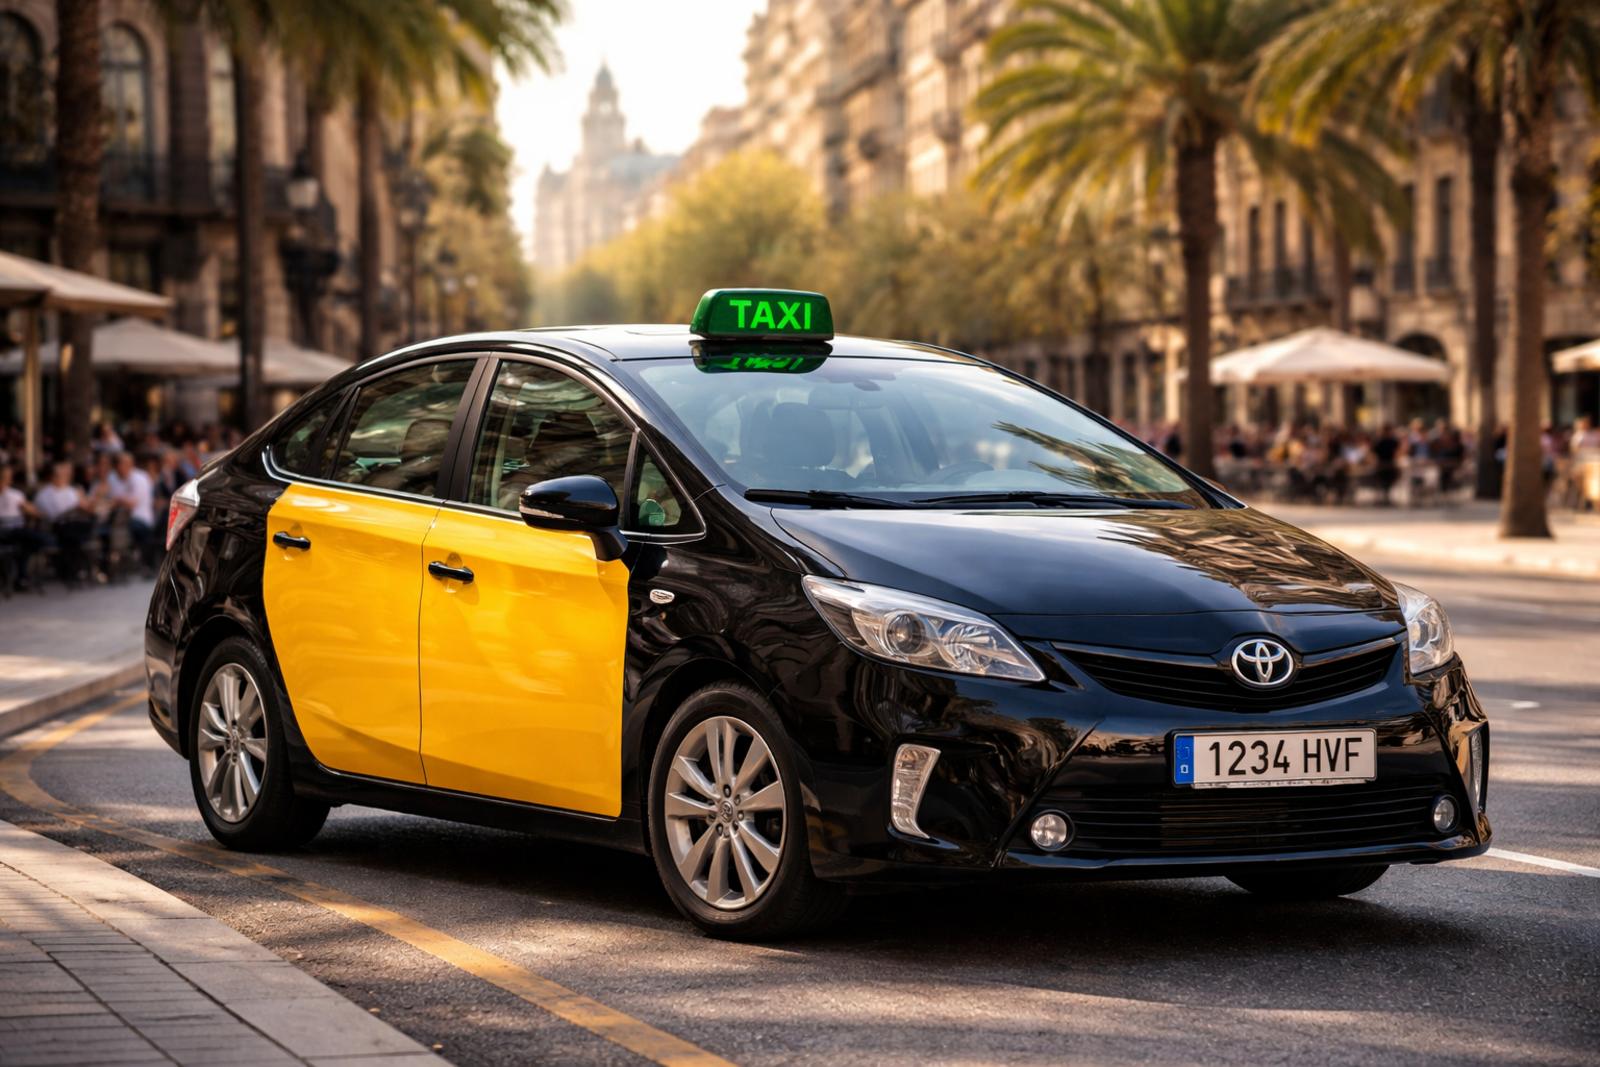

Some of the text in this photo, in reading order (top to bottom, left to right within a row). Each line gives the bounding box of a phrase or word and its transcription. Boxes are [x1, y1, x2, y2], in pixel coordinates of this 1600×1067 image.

[729, 299, 812, 330] TAXI
[1208, 737, 1363, 776] 1234 HVF
